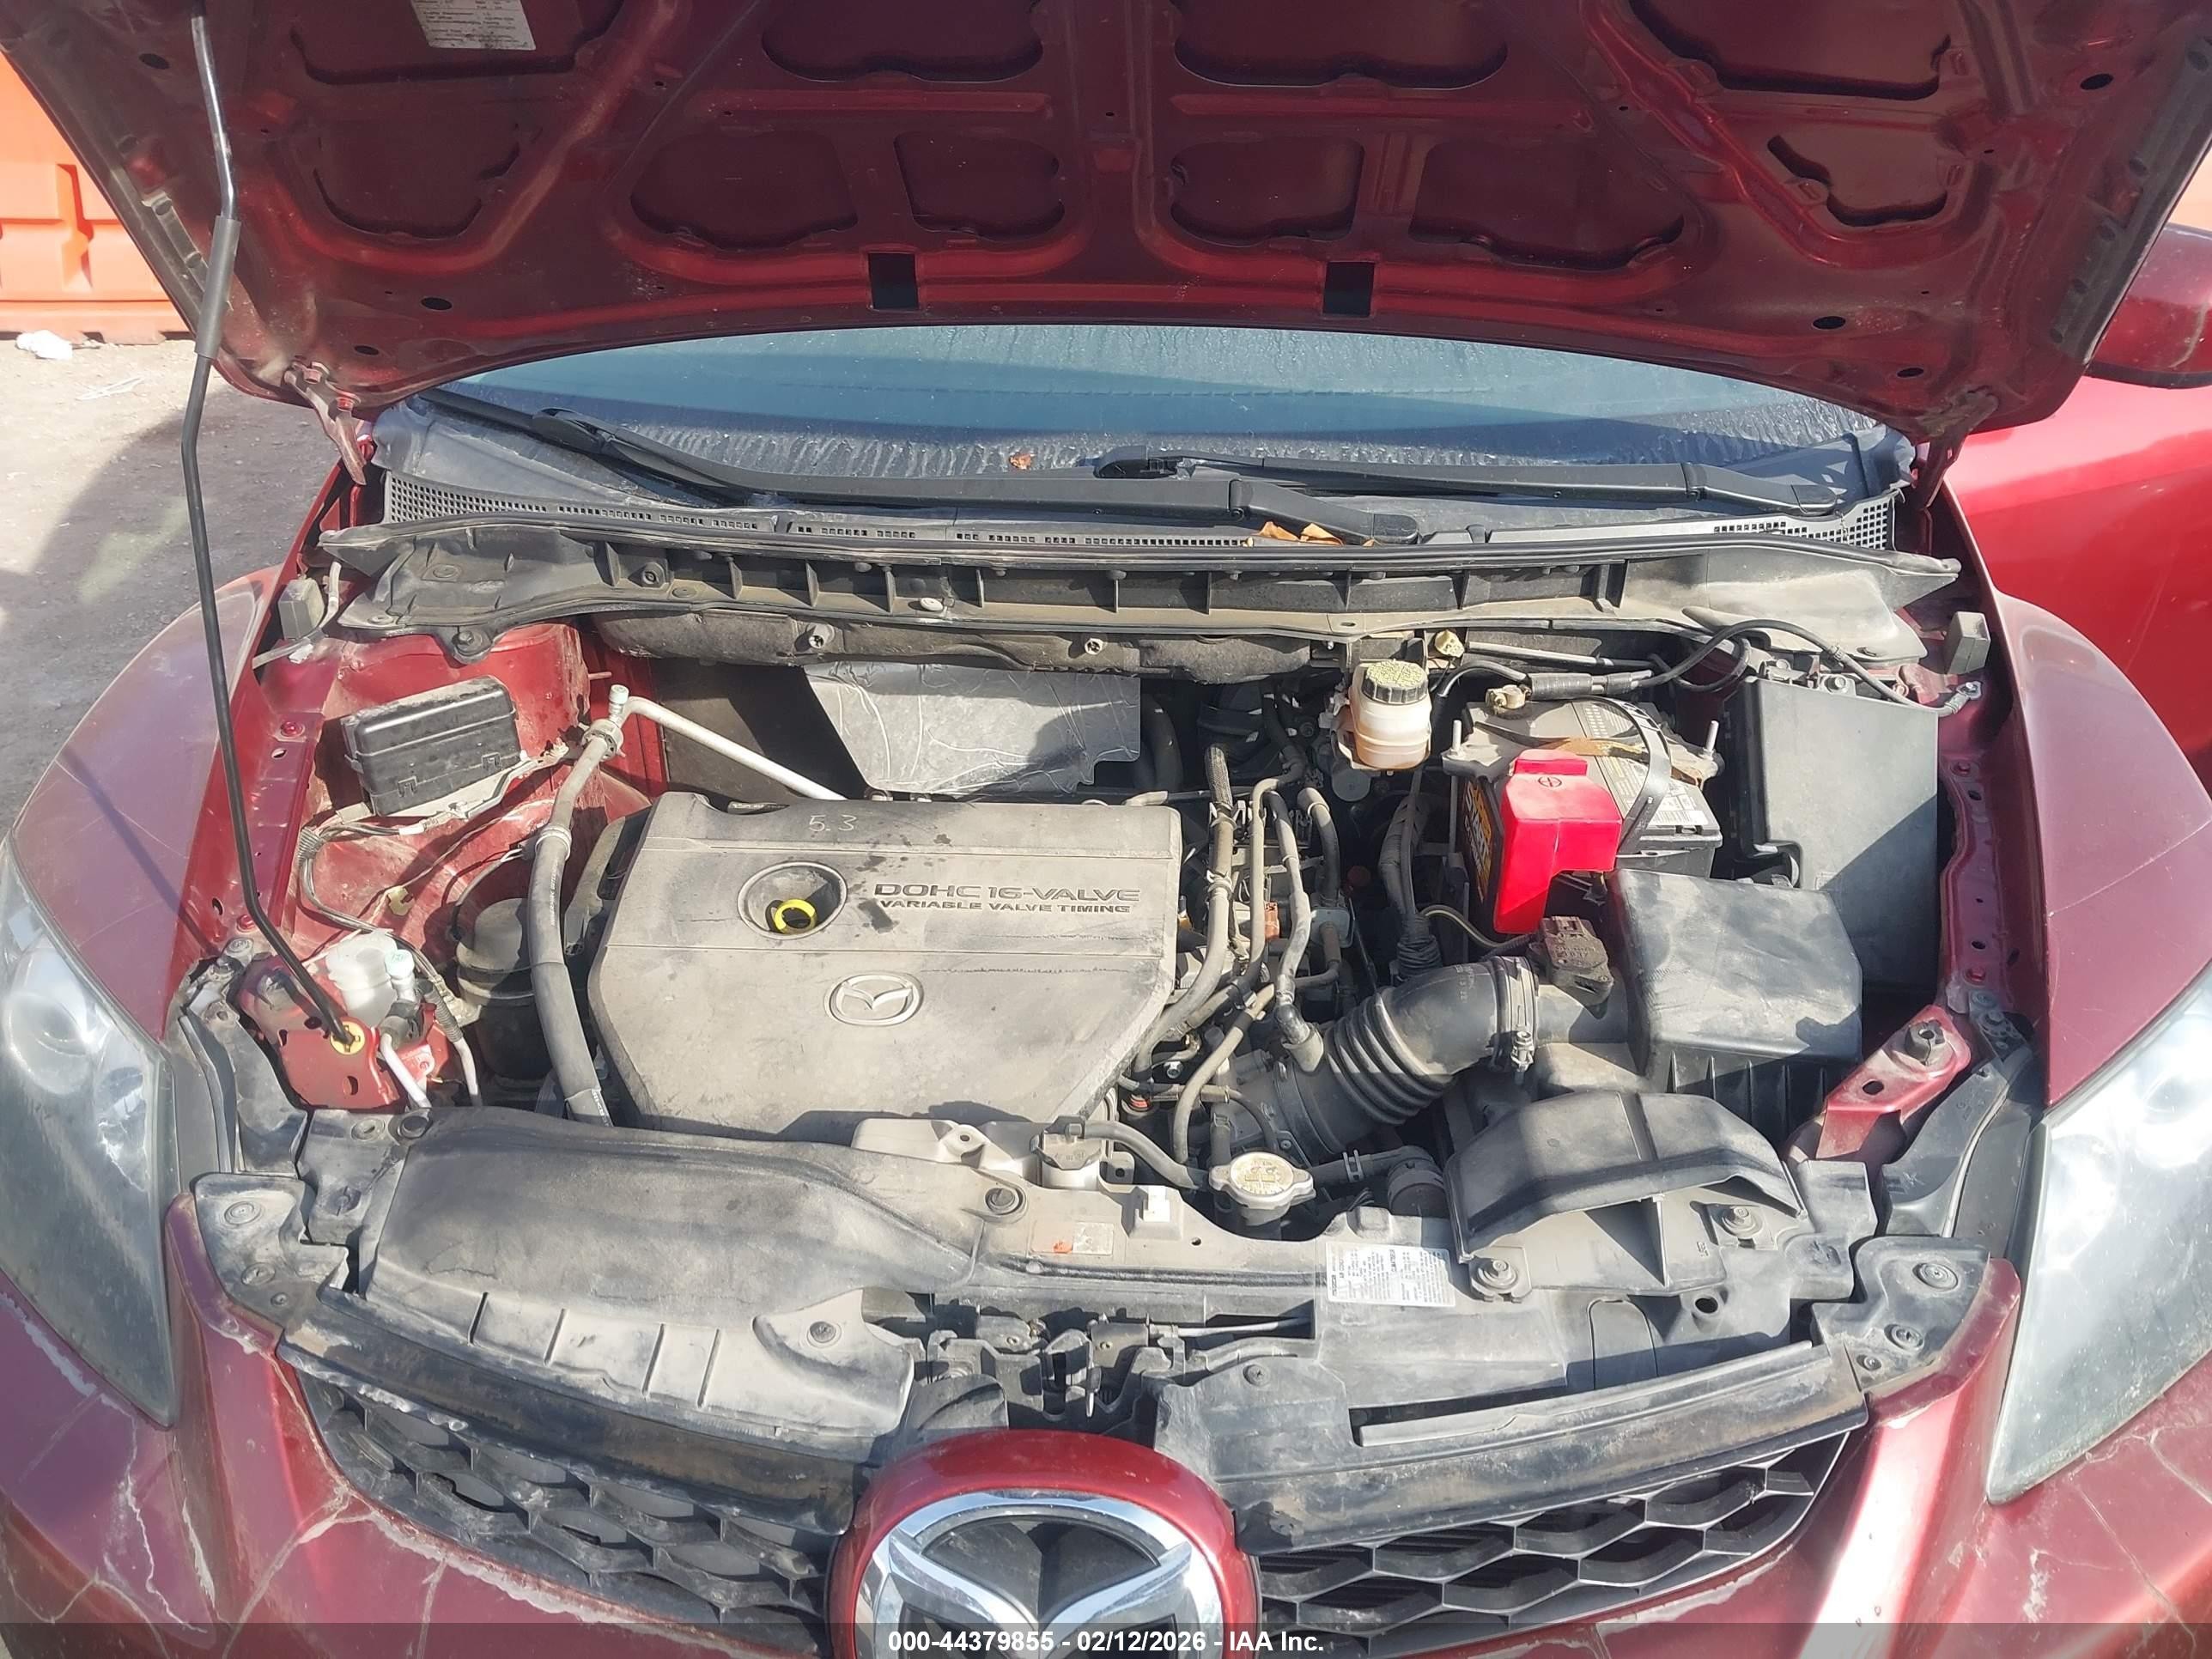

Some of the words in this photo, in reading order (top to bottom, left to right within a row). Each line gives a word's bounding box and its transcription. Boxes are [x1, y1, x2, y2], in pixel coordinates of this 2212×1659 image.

[874, 884, 982, 898] DOHC
[988, 886, 1140, 902] 16-VALVE
[879, 901, 983, 910] VARIABLE
[989, 903, 1053, 913] VALVE
[1057, 904, 1132, 914] TIMING
